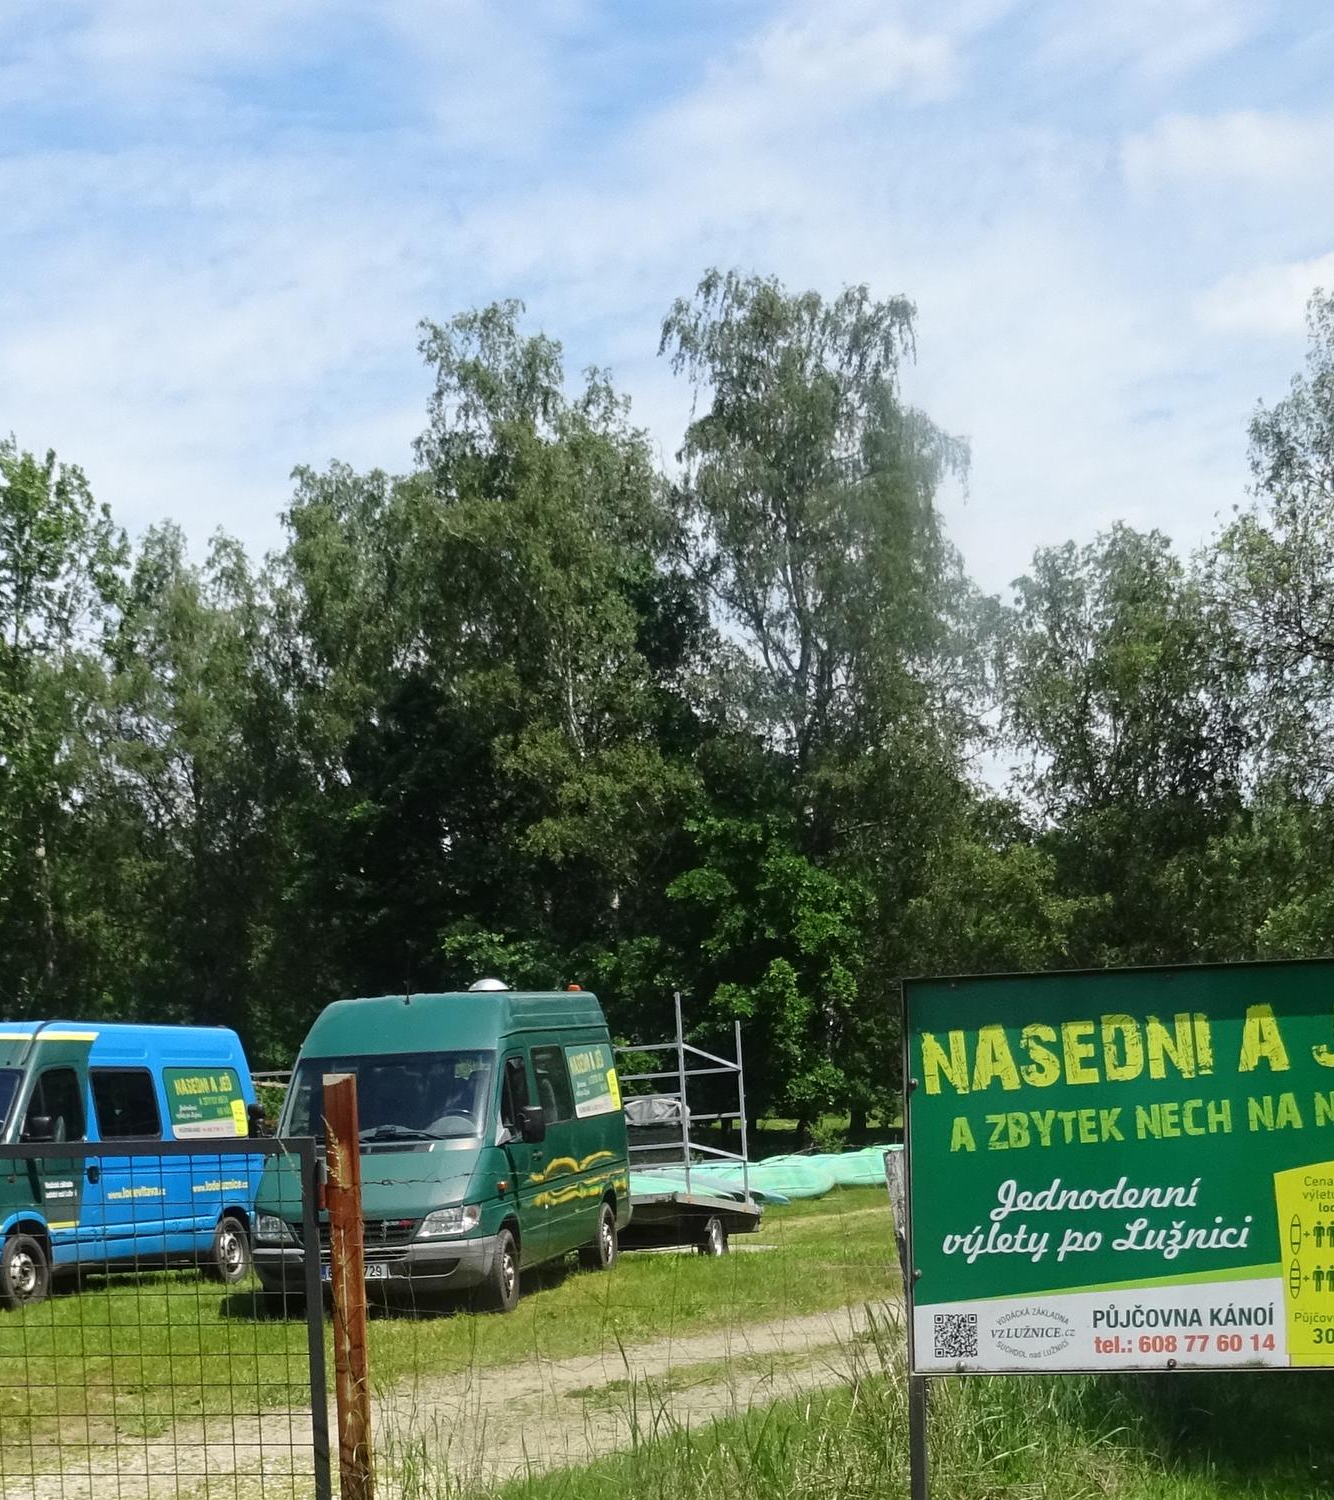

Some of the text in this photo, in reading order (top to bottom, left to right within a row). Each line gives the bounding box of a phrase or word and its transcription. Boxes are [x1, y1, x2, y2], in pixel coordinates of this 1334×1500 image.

[921, 1012, 1213, 1095] NASEDNI
[1238, 1002, 1291, 1072] A
[950, 1116, 976, 1152] A
[985, 1107, 1125, 1150] ZBYTEK
[1135, 1099, 1232, 1140] NECH
[1248, 1092, 1303, 1132] NA
[989, 1176, 1201, 1220] Jednodenní
[1304, 1176, 1334, 1187] Cena
[942, 1215, 1253, 1264] výlety po Lužnici
[1092, 1302, 1275, 1328] PŮJČOVNA KÁNOÍ
[1094, 1333, 1276, 1354] tel.: 608 77 60 14
